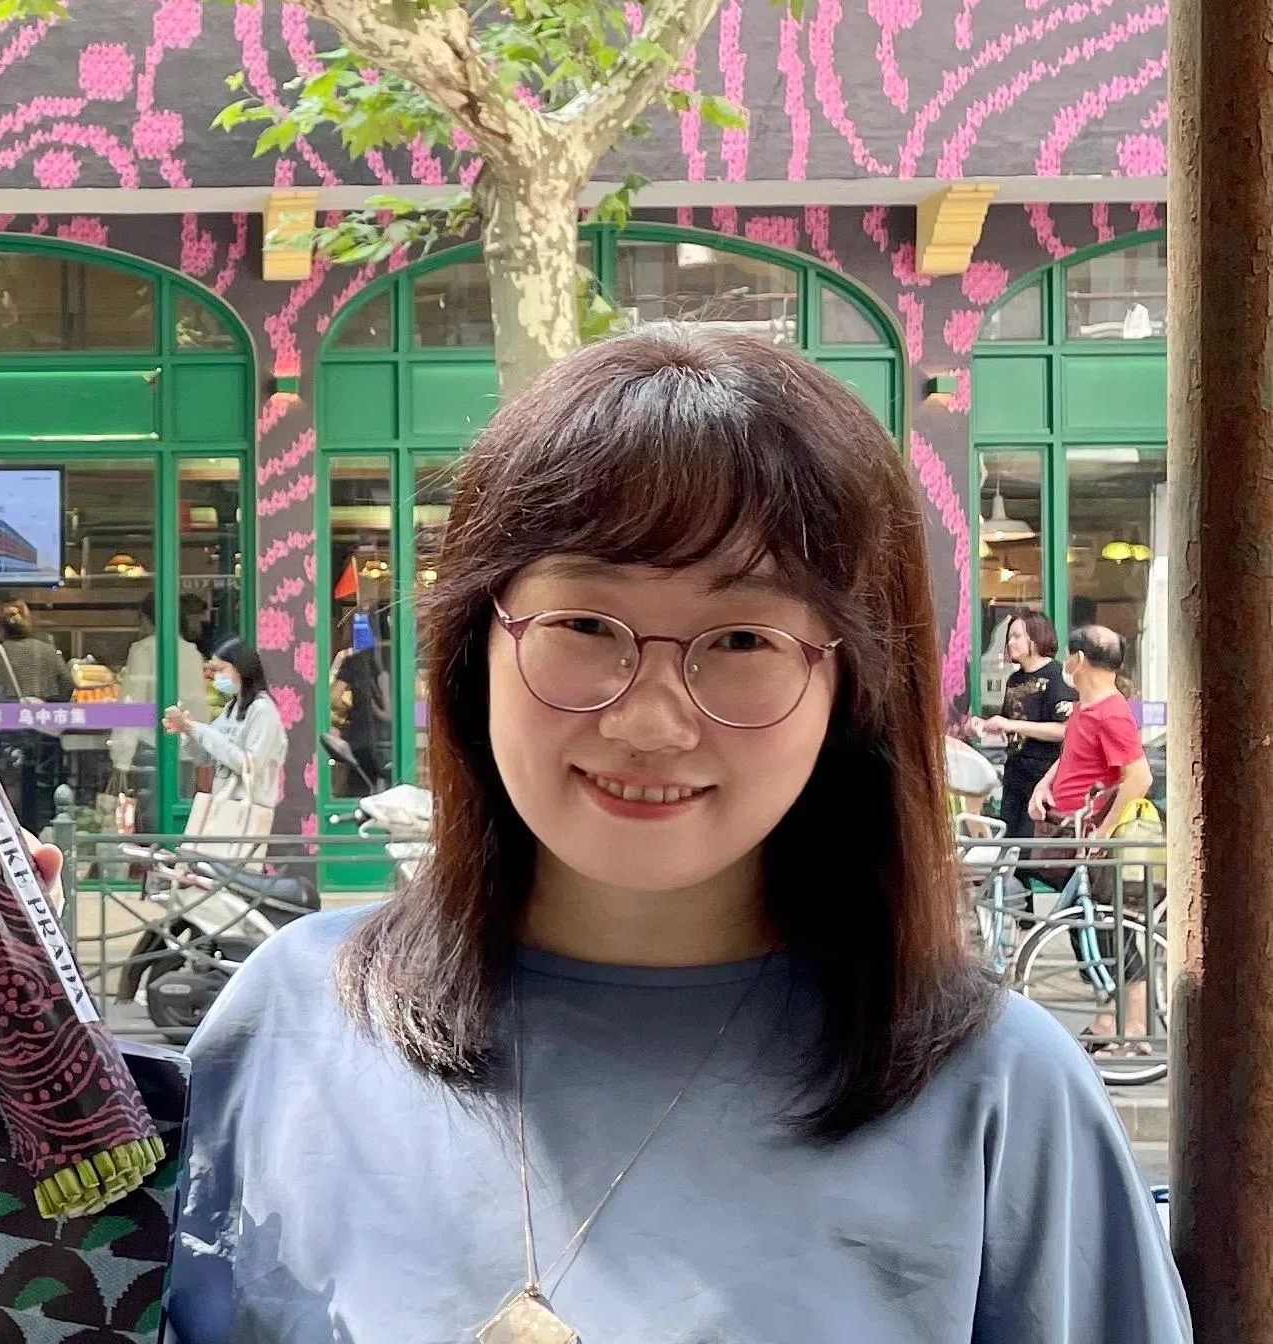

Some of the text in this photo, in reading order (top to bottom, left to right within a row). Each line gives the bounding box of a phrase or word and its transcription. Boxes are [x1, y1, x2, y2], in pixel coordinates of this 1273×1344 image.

[18, 708, 86, 725] 乌中市集
[27, 896, 83, 1004] PRADA
